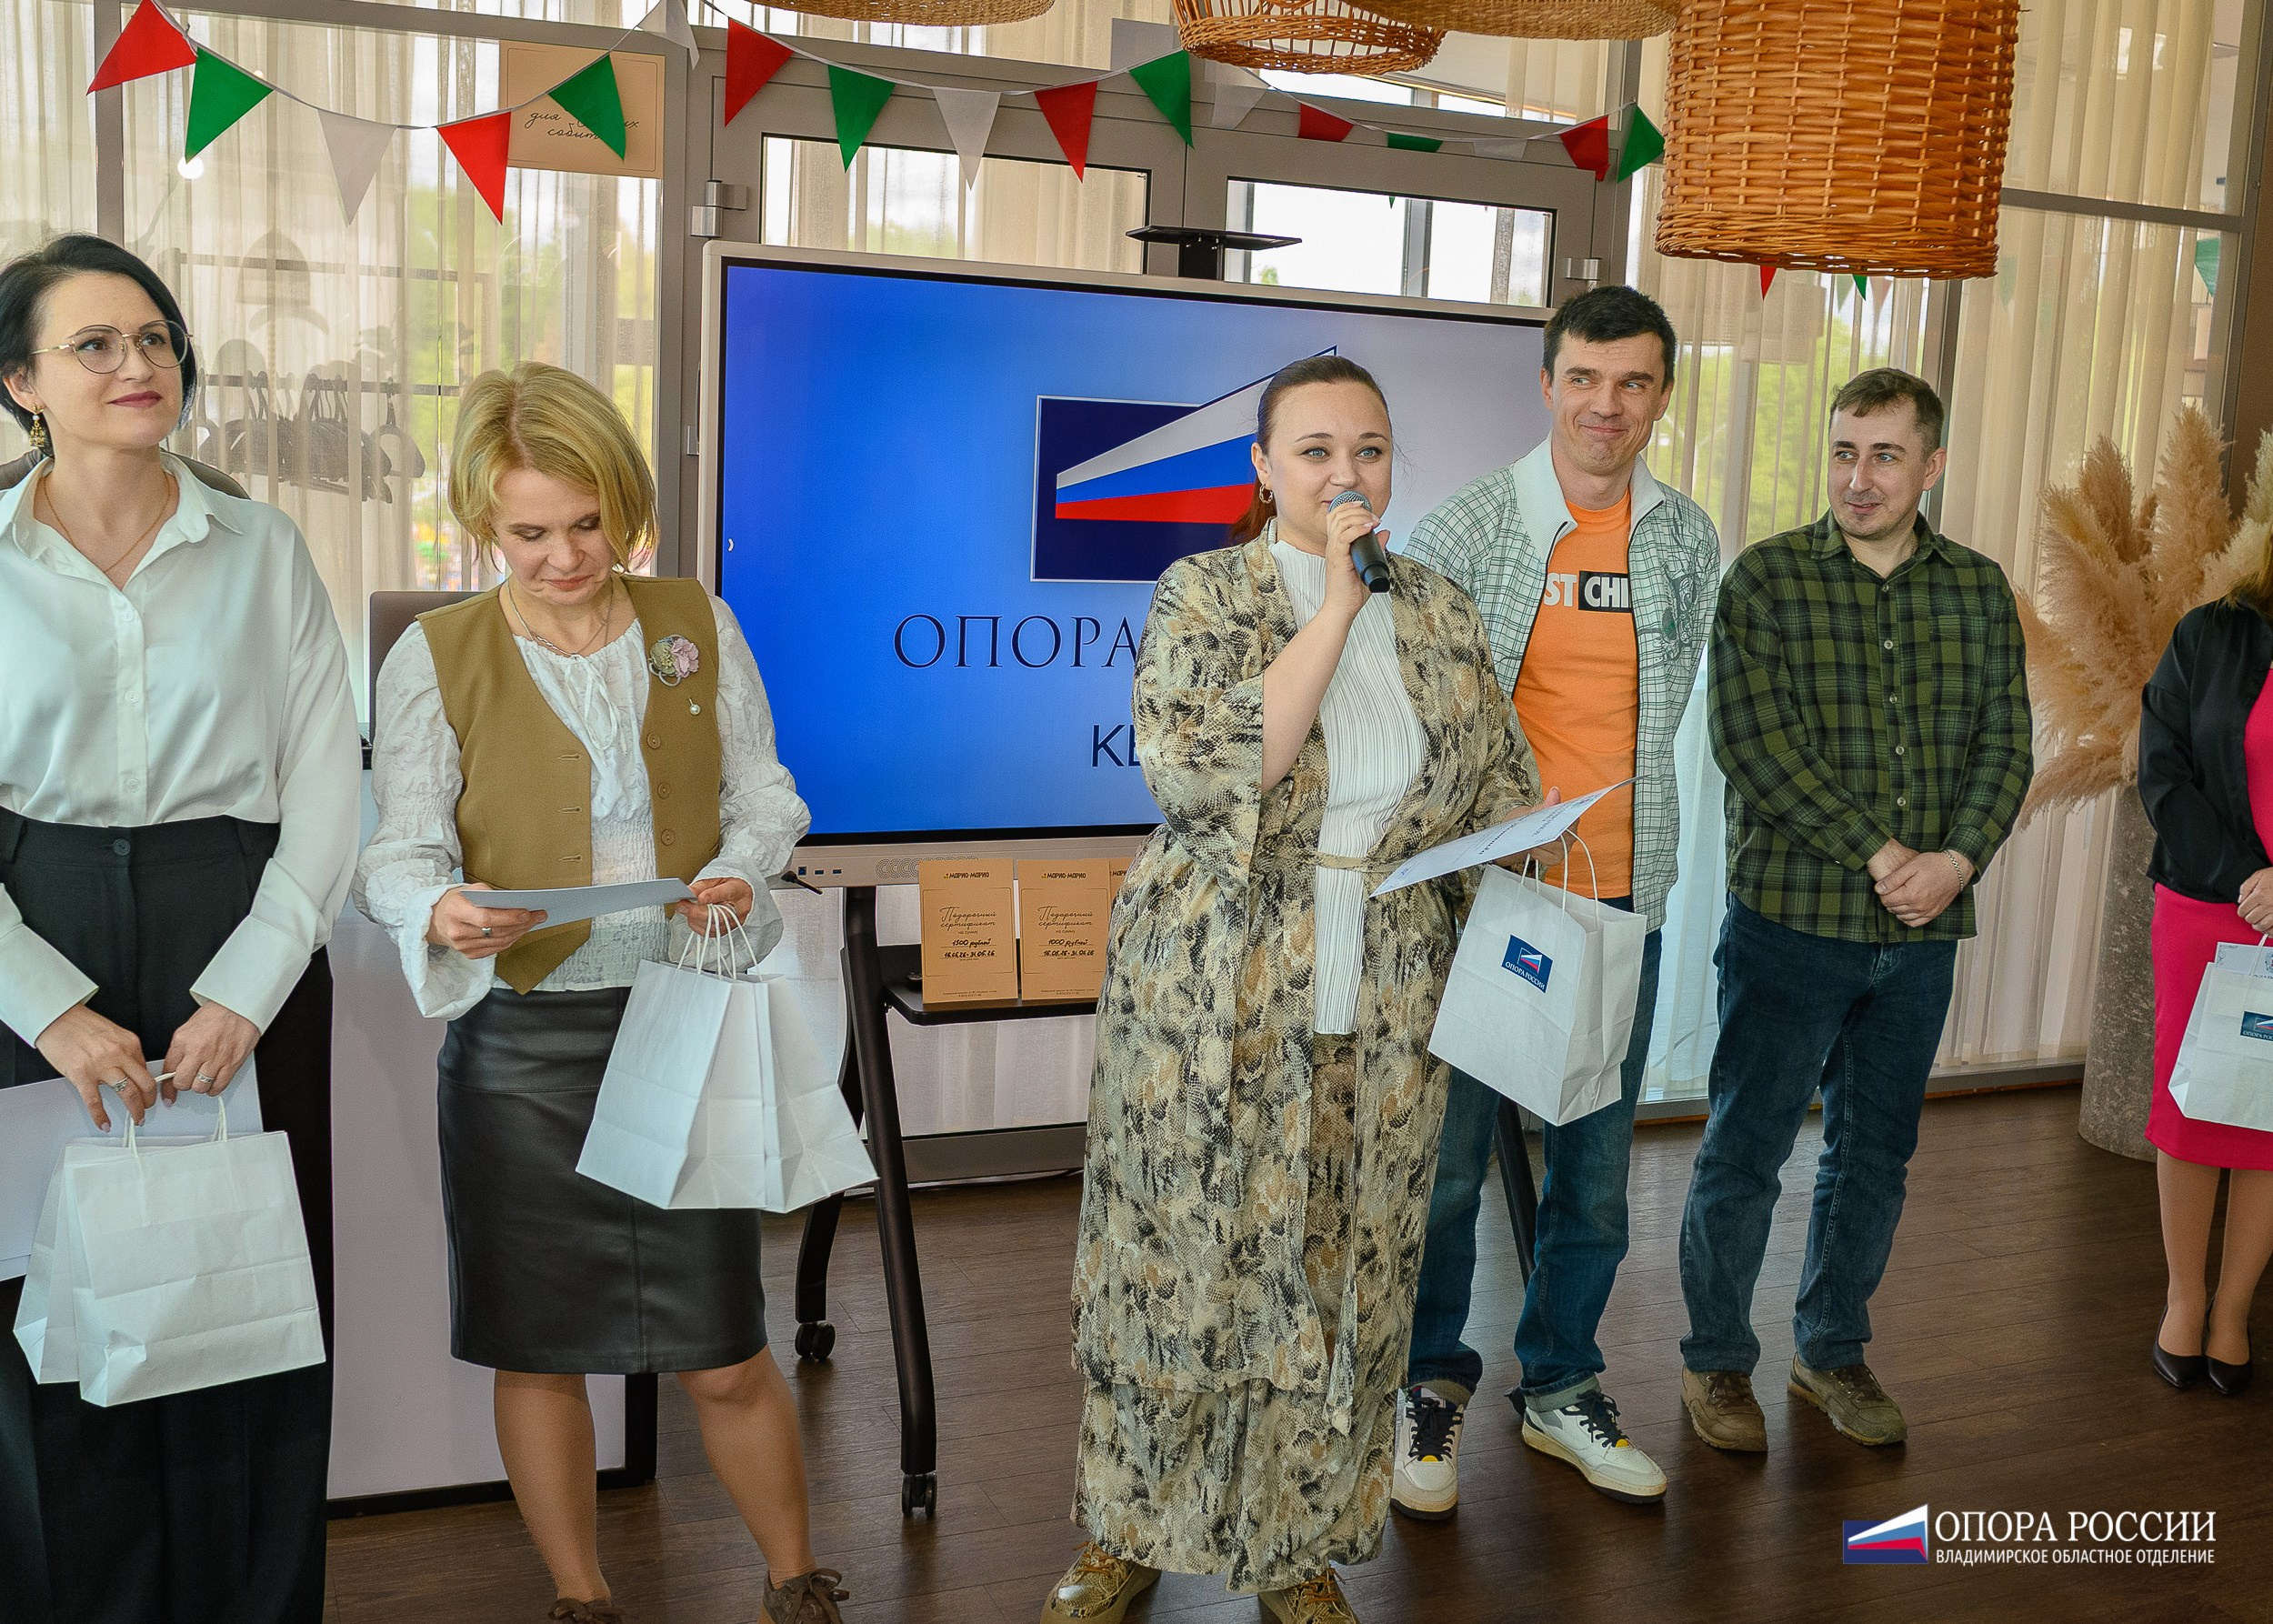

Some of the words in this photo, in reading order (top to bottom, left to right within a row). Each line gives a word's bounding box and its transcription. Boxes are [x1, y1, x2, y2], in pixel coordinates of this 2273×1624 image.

[525, 113, 561, 129] для
[547, 123, 600, 140] событ
[1584, 576, 1632, 608] CHI
[894, 614, 1137, 668] ОПОРА
[1505, 961, 1525, 977] ОПОРА
[1525, 971, 1546, 990] РОССИИ
